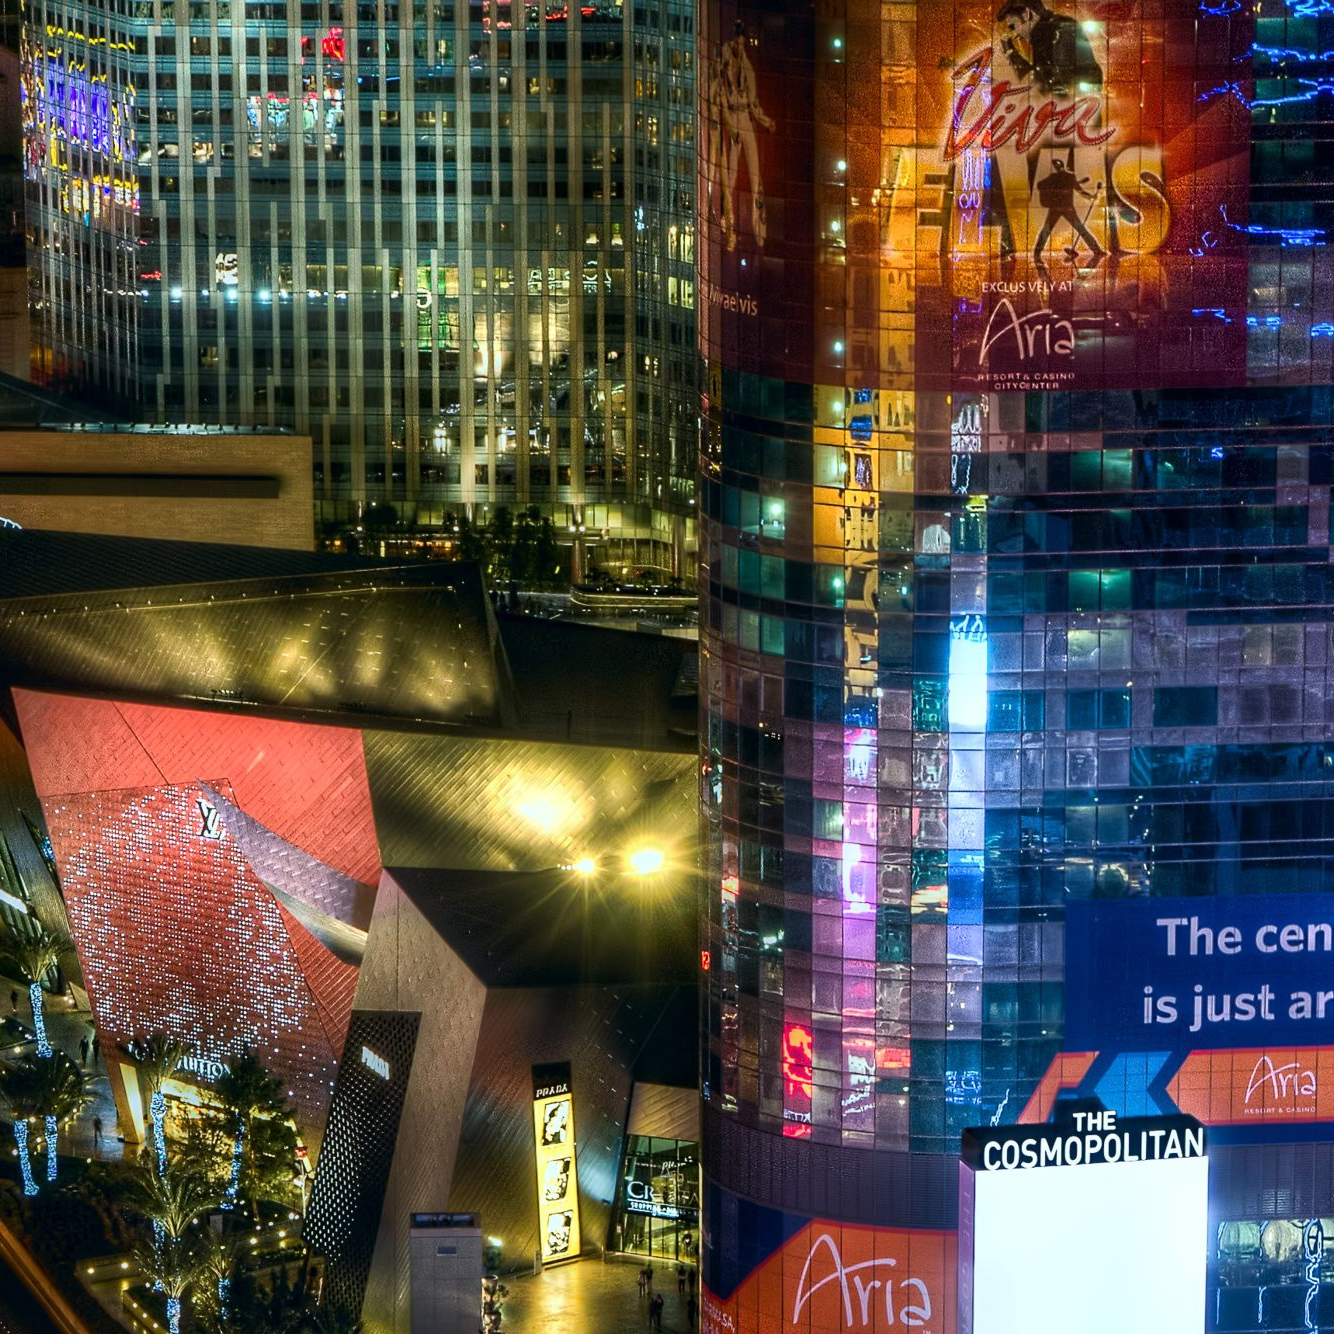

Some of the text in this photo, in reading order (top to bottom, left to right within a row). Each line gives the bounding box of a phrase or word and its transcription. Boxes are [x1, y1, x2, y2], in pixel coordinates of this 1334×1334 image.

[944, 47, 1115, 162] Viva
[1059, 281, 1074, 293] AT
[978, 298, 1075, 365] Aria
[1033, 372, 1075, 380] CASINO
[1156, 915, 1242, 956] The
[1143, 985, 1178, 1024] is
[1189, 984, 1276, 1032] just
[535, 1083, 568, 1098] PRADA
[1244, 1055, 1317, 1105] Aria
[1072, 1110, 1117, 1132] THE
[983, 1128, 1204, 1171] COSMOPOLITAN
[793, 1233, 932, 1328] Aria
